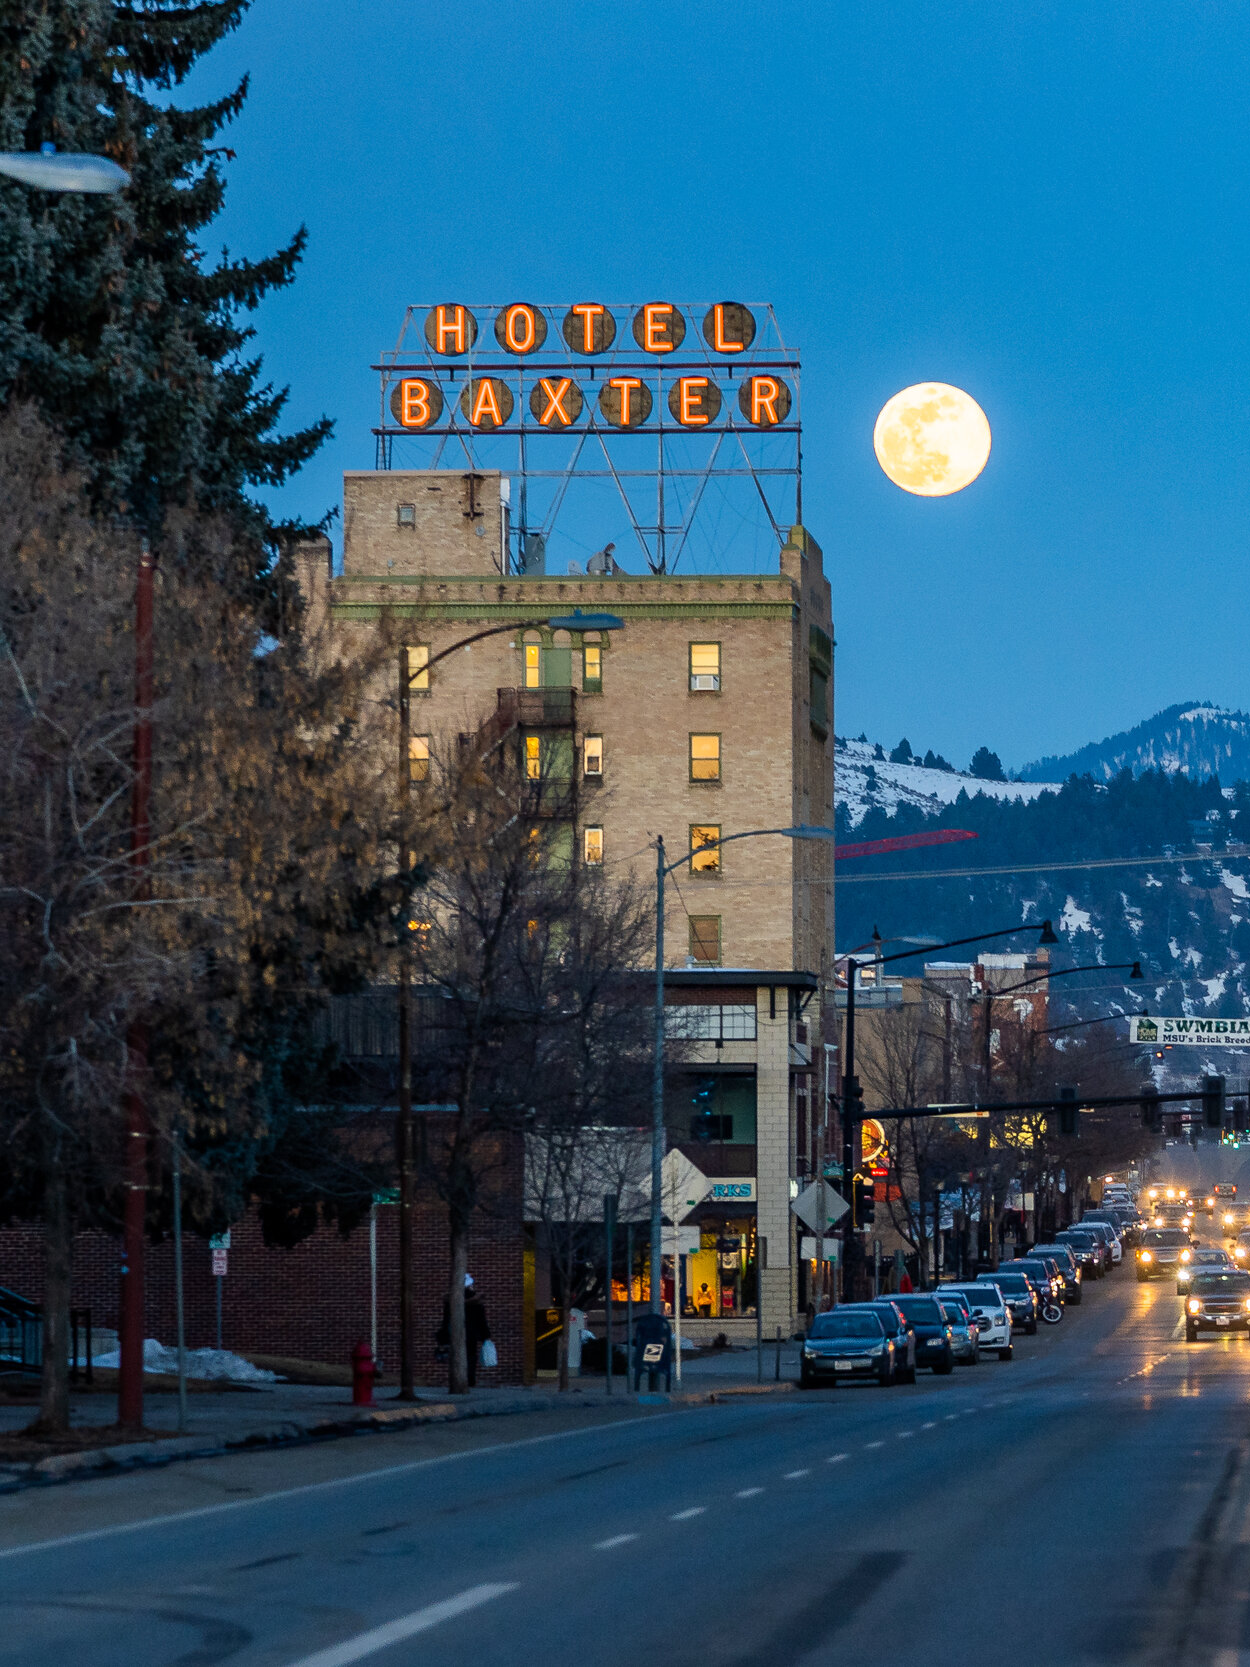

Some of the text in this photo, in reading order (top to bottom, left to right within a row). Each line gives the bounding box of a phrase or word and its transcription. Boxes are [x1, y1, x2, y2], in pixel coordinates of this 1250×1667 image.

[436, 304, 744, 353] HOTEL
[401, 376, 779, 427] BAXTER
[1163, 1020, 1250, 1034] SWMBIA
[1163, 1034, 1193, 1043] MSU's
[1196, 1034, 1222, 1043] Brick
